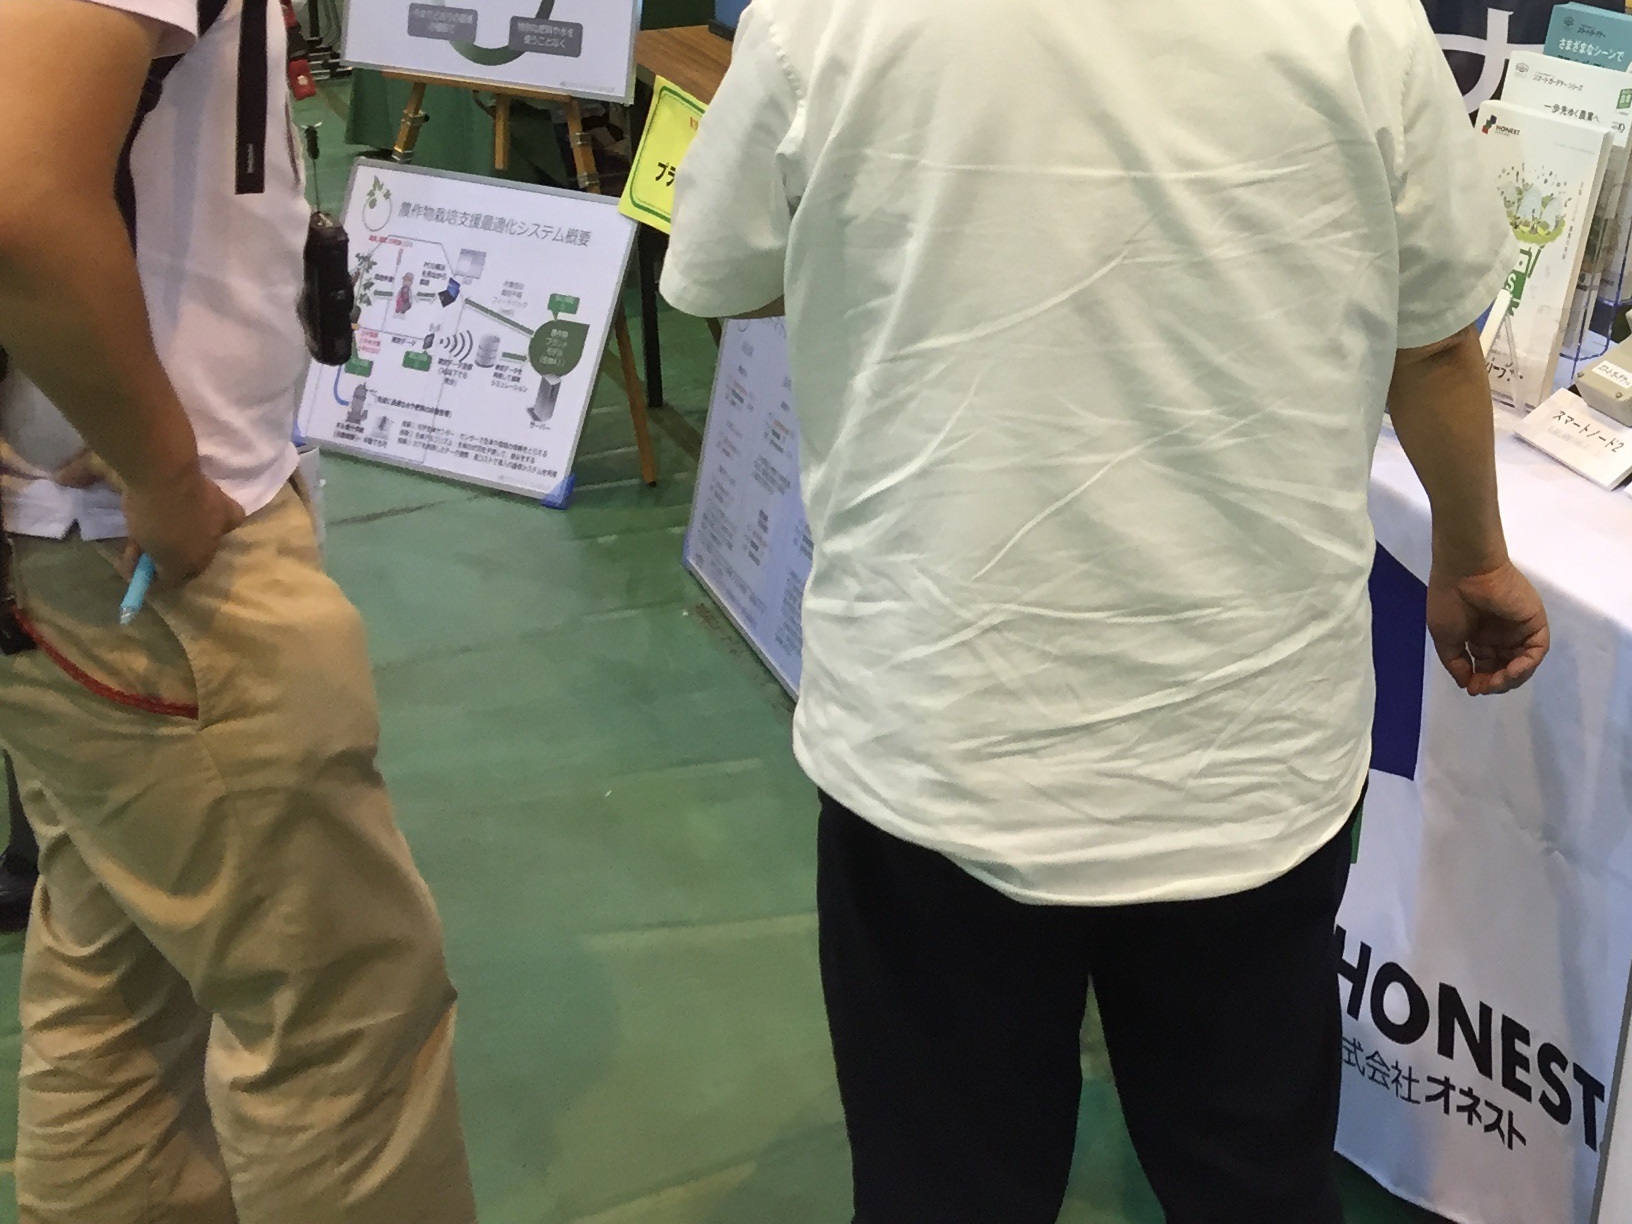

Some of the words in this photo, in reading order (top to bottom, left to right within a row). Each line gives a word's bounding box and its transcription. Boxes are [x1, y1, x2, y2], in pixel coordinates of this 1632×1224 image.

[1558, 38, 1625, 63] さまざまなシーンで
[398, 201, 592, 247] 農作物栽培支援最適化システム概要
[1552, 410, 1625, 453] スマートノード2
[1333, 923, 1606, 1153] HONEST
